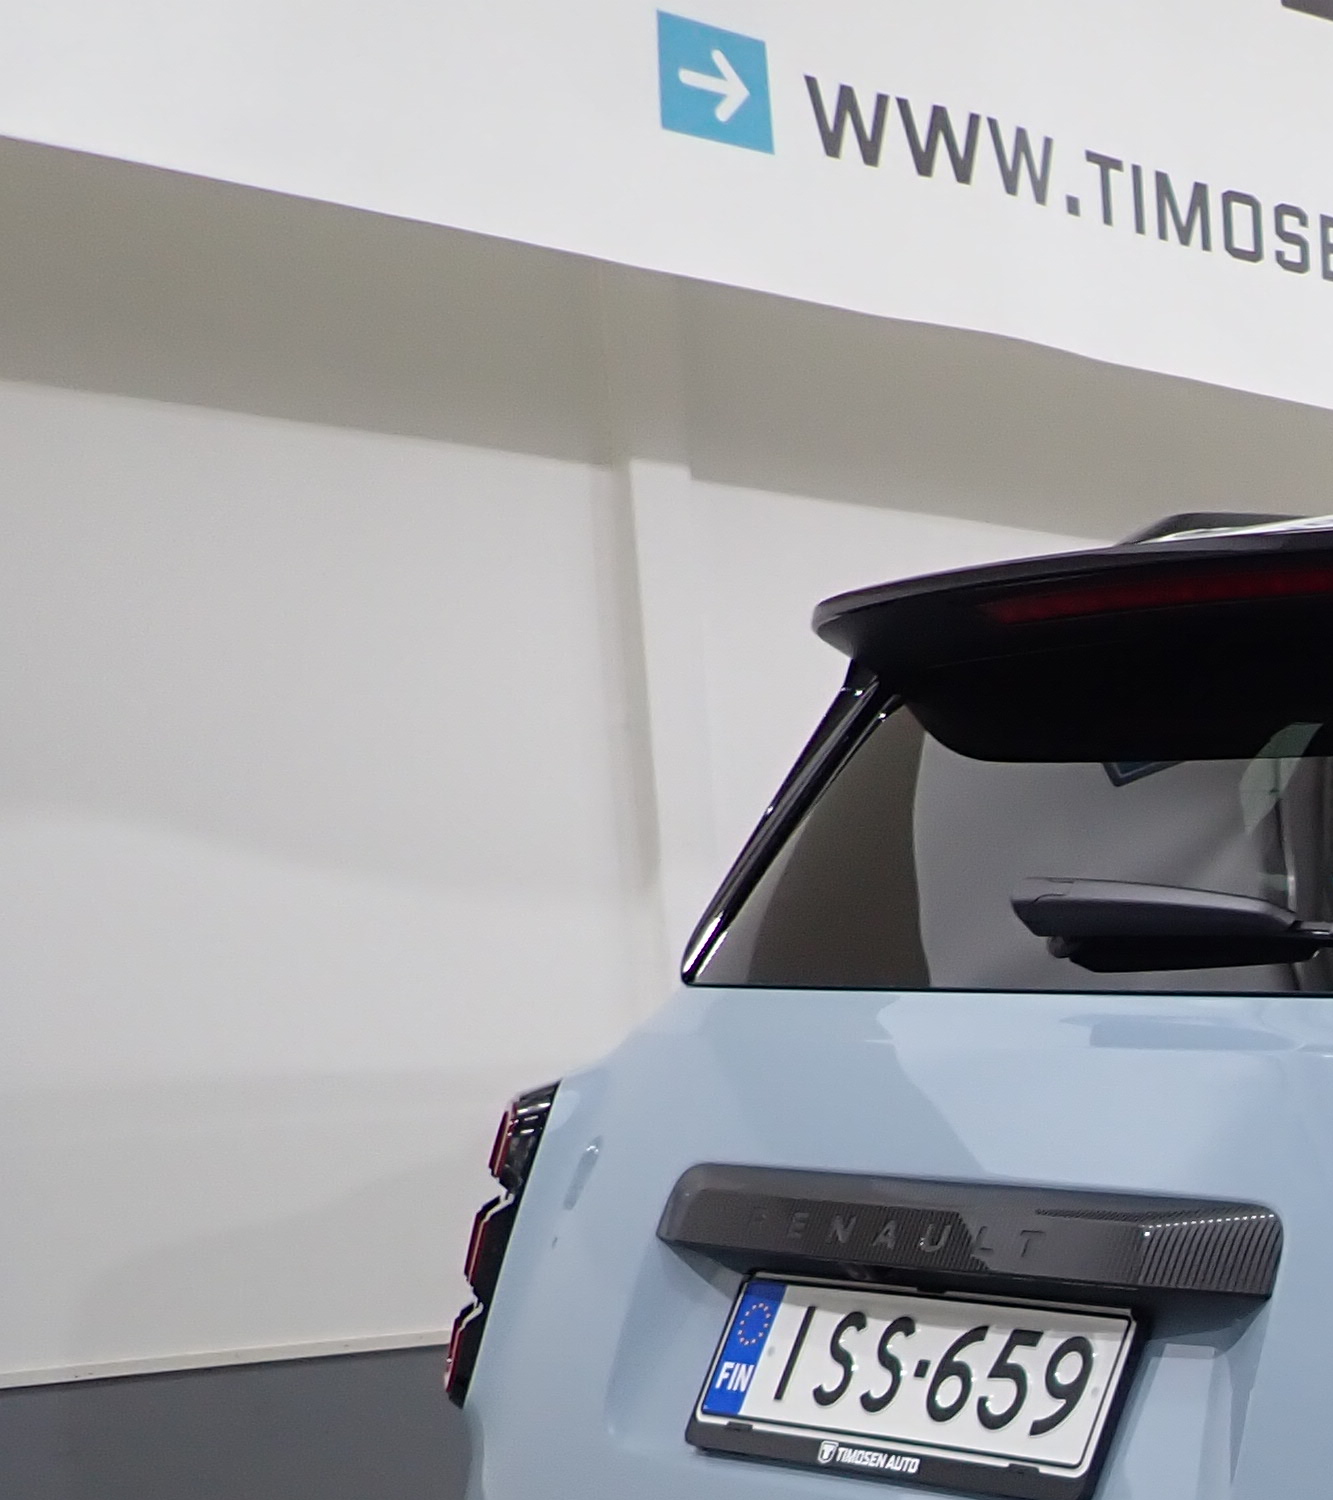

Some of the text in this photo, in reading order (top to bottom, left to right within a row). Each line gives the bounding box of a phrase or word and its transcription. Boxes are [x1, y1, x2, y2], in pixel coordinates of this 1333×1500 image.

[715, 1361, 755, 1392] FIN
[773, 1305, 1096, 1437] ISS-659
[836, 1447, 887, 1469] TIMOSEN
[885, 1455, 920, 1474] AUTO
